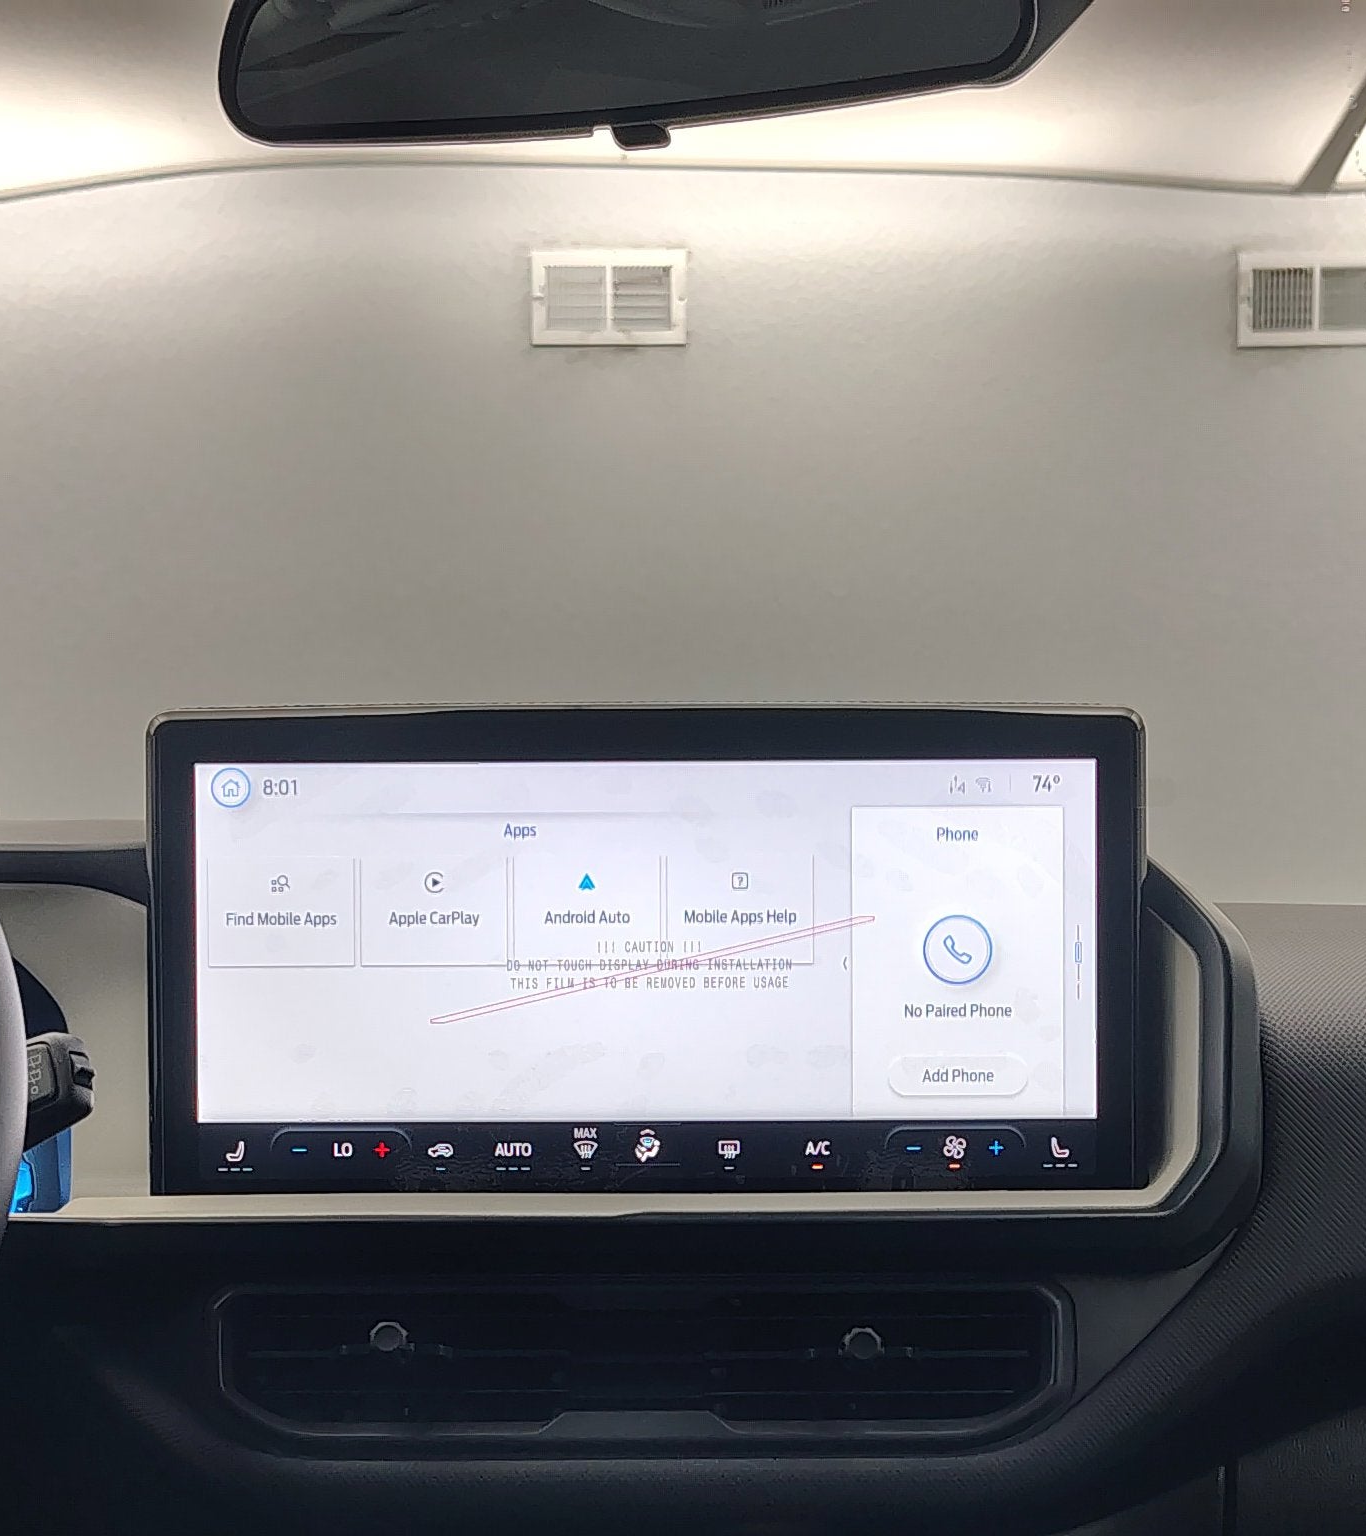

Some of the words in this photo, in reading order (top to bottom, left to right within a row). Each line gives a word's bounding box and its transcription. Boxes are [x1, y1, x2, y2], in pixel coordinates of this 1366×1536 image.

[262, 779, 298, 796] 8:01
[503, 823, 537, 840] Apps
[936, 827, 979, 842] Phone
[225, 912, 254, 926] Find
[257, 912, 301, 926] Mobile
[304, 912, 337, 929] Apps
[389, 911, 426, 928] Apple
[429, 911, 480, 928] CarPlay
[544, 909, 595, 925] Android
[598, 909, 631, 925] Auto
[684, 908, 727, 924] Mobile
[731, 909, 763, 926] Apps
[766, 908, 797, 925] Help
[624, 940, 674, 953] CAUTION
[506, 959, 520, 972] DO
[528, 959, 549, 971] NOT
[599, 958, 649, 971] DISPLAY
[656, 958, 700, 971] DURING
[707, 958, 792, 971] INSTALLATION
[510, 977, 538, 989] THIS
[546, 977, 575, 989] FILM
[583, 977, 596, 989] IS
[605, 977, 617, 988] TO
[624, 976, 639, 989] BE
[646, 976, 696, 989] REMOVED
[703, 976, 746, 989] BEFORE
[754, 976, 789, 988] USAGE
[904, 1004, 922, 1018] No
[925, 1003, 967, 1018] Paired
[970, 1003, 1013, 1018] Phone
[922, 1068, 949, 1083] Add
[952, 1068, 994, 1083] Phone
[573, 1127, 598, 1139] MAX
[332, 1142, 353, 1158] LO
[494, 1142, 533, 1158] AUTO
[804, 1141, 831, 1156] A/C
